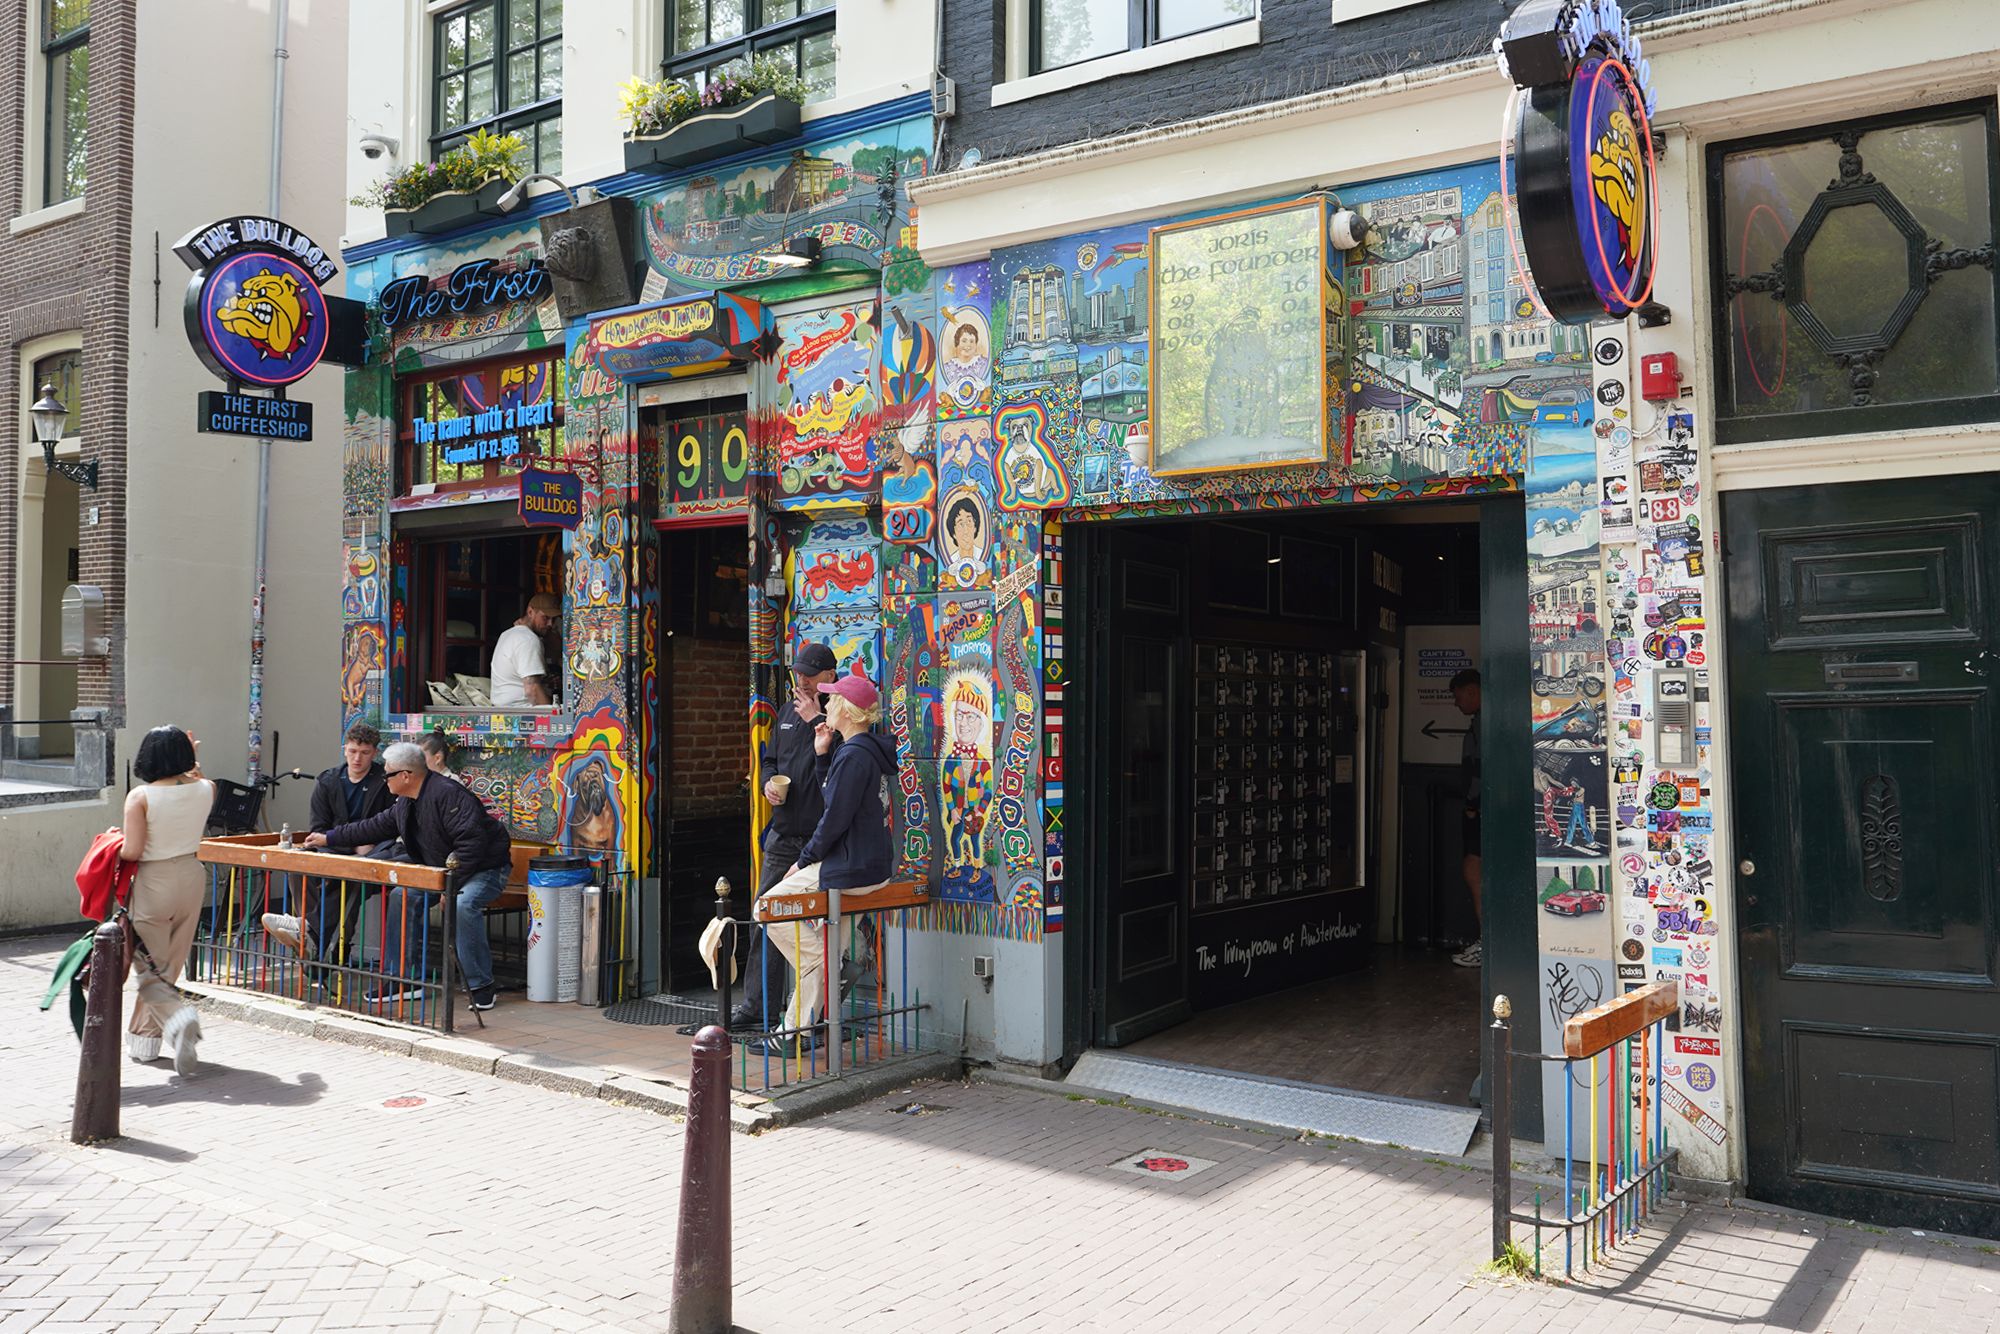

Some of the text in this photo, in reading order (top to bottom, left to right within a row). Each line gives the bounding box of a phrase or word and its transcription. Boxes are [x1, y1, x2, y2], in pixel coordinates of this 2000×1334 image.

[192, 218, 335, 281] THE BULLDOG
[666, 252, 739, 280] BULLDOG
[380, 259, 545, 328] The First
[1283, 274, 1308, 295] 16
[1171, 294, 1195, 312] 29
[1281, 297, 1312, 314] 04
[1167, 314, 1195, 331] 08
[1159, 330, 1204, 353] 1976
[573, 367, 617, 400] JUICE
[222, 394, 299, 417] THE FIRST
[211, 413, 308, 438] COFFEESHOP
[413, 402, 554, 444] The name with a heart
[1088, 418, 1150, 448] CANAD
[444, 436, 521, 465] Founded 17-12-1975
[542, 481, 562, 496] THE
[525, 496, 577, 516] BULLDOG
[890, 509, 924, 538] 90
[1421, 659, 1442, 667] WHAT
[1421, 669, 1457, 677] LOOKING
[998, 690, 1033, 860] BULLDOG
[1196, 911, 1358, 978] The livingroom of Amsterdam
[1695, 1114, 1728, 1145] GRANA
